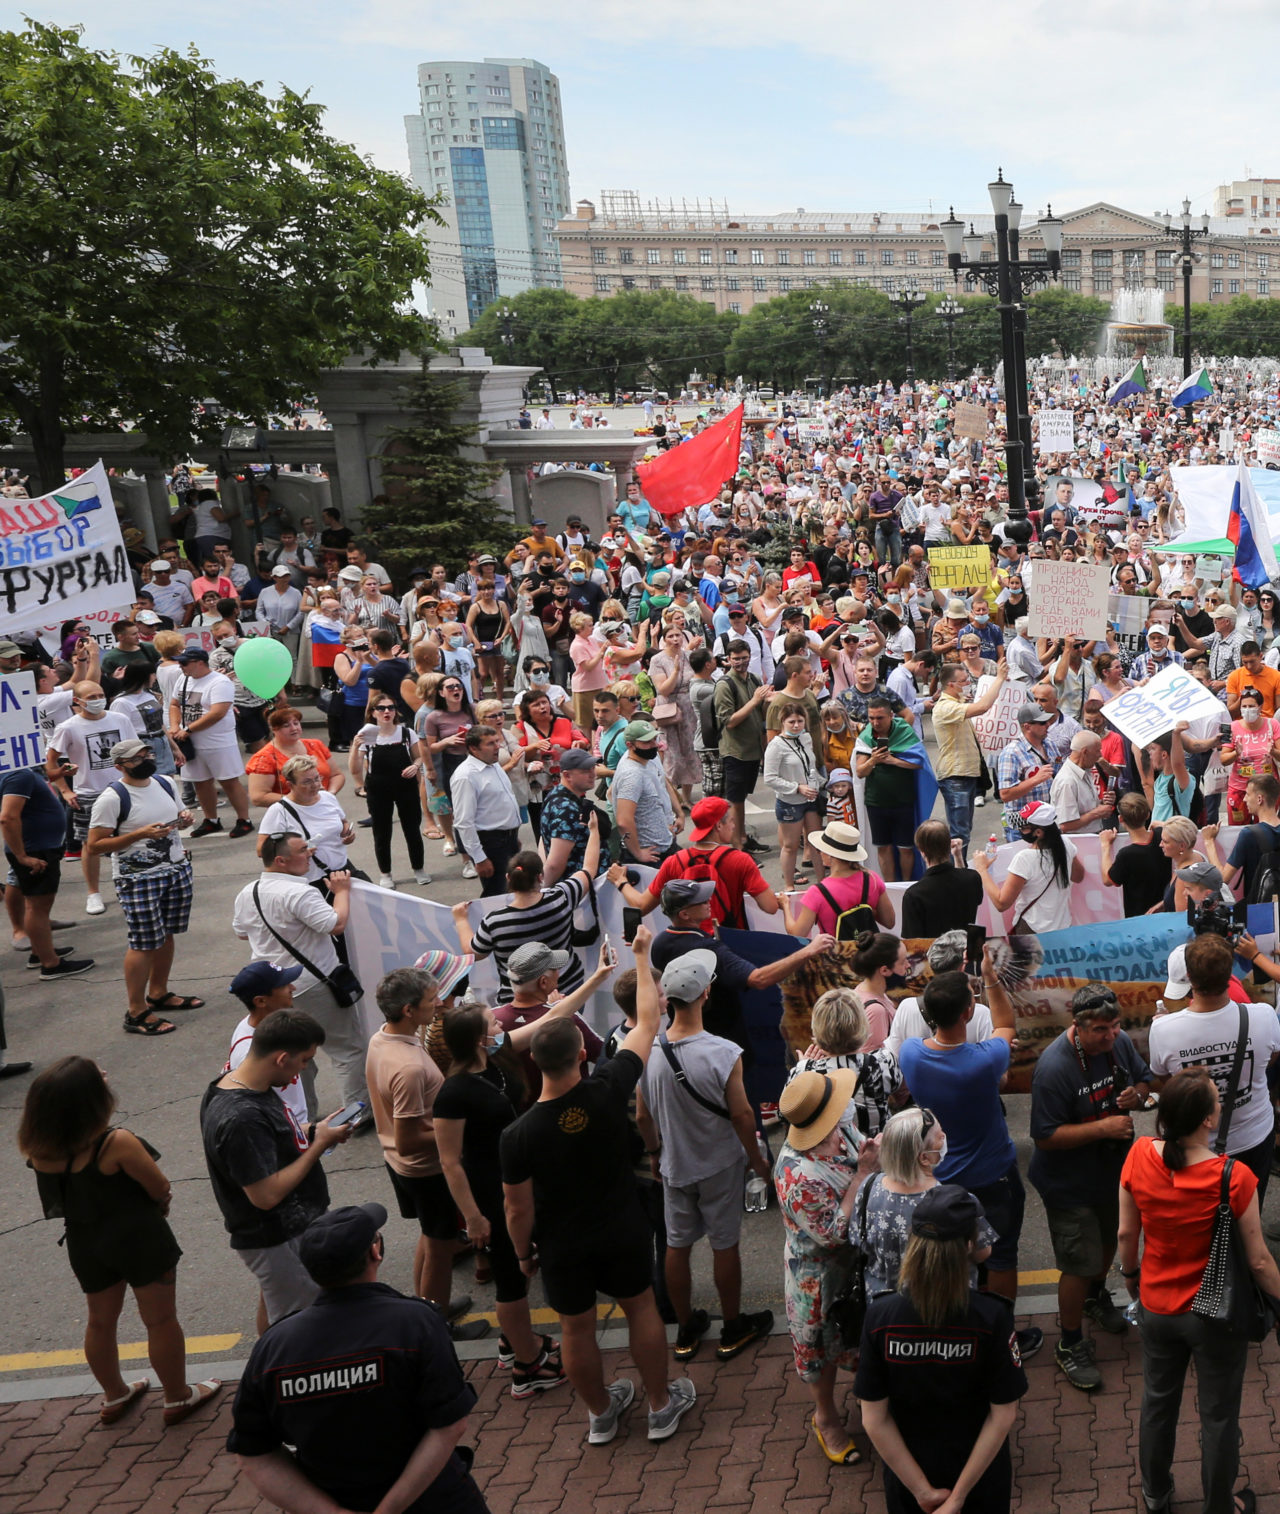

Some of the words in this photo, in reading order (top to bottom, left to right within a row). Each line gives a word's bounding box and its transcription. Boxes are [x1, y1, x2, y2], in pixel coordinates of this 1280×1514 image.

[1079, 506, 1098, 514] Руки
[1100, 508, 1124, 516] прочь
[1037, 563, 1096, 578] ПРОСНИСЬ
[1050, 575, 1088, 588] НАРОД
[1036, 583, 1094, 598] ПРОСНИСЬ
[1042, 595, 1087, 606] СТРАНА
[1035, 605, 1064, 616] ВЕДЬ
[1071, 606, 1101, 618] ВАМИ
[1041, 615, 1085, 626] ПРАВИТ
[1040, 625, 1086, 637] САТАНА
[1180, 1038, 1252, 1058] ВИДЕОСТУДЯ
[889, 1341, 972, 1360] ПОЛИЦИЯ
[281, 1363, 378, 1397] ПОЛИЦИЯ
